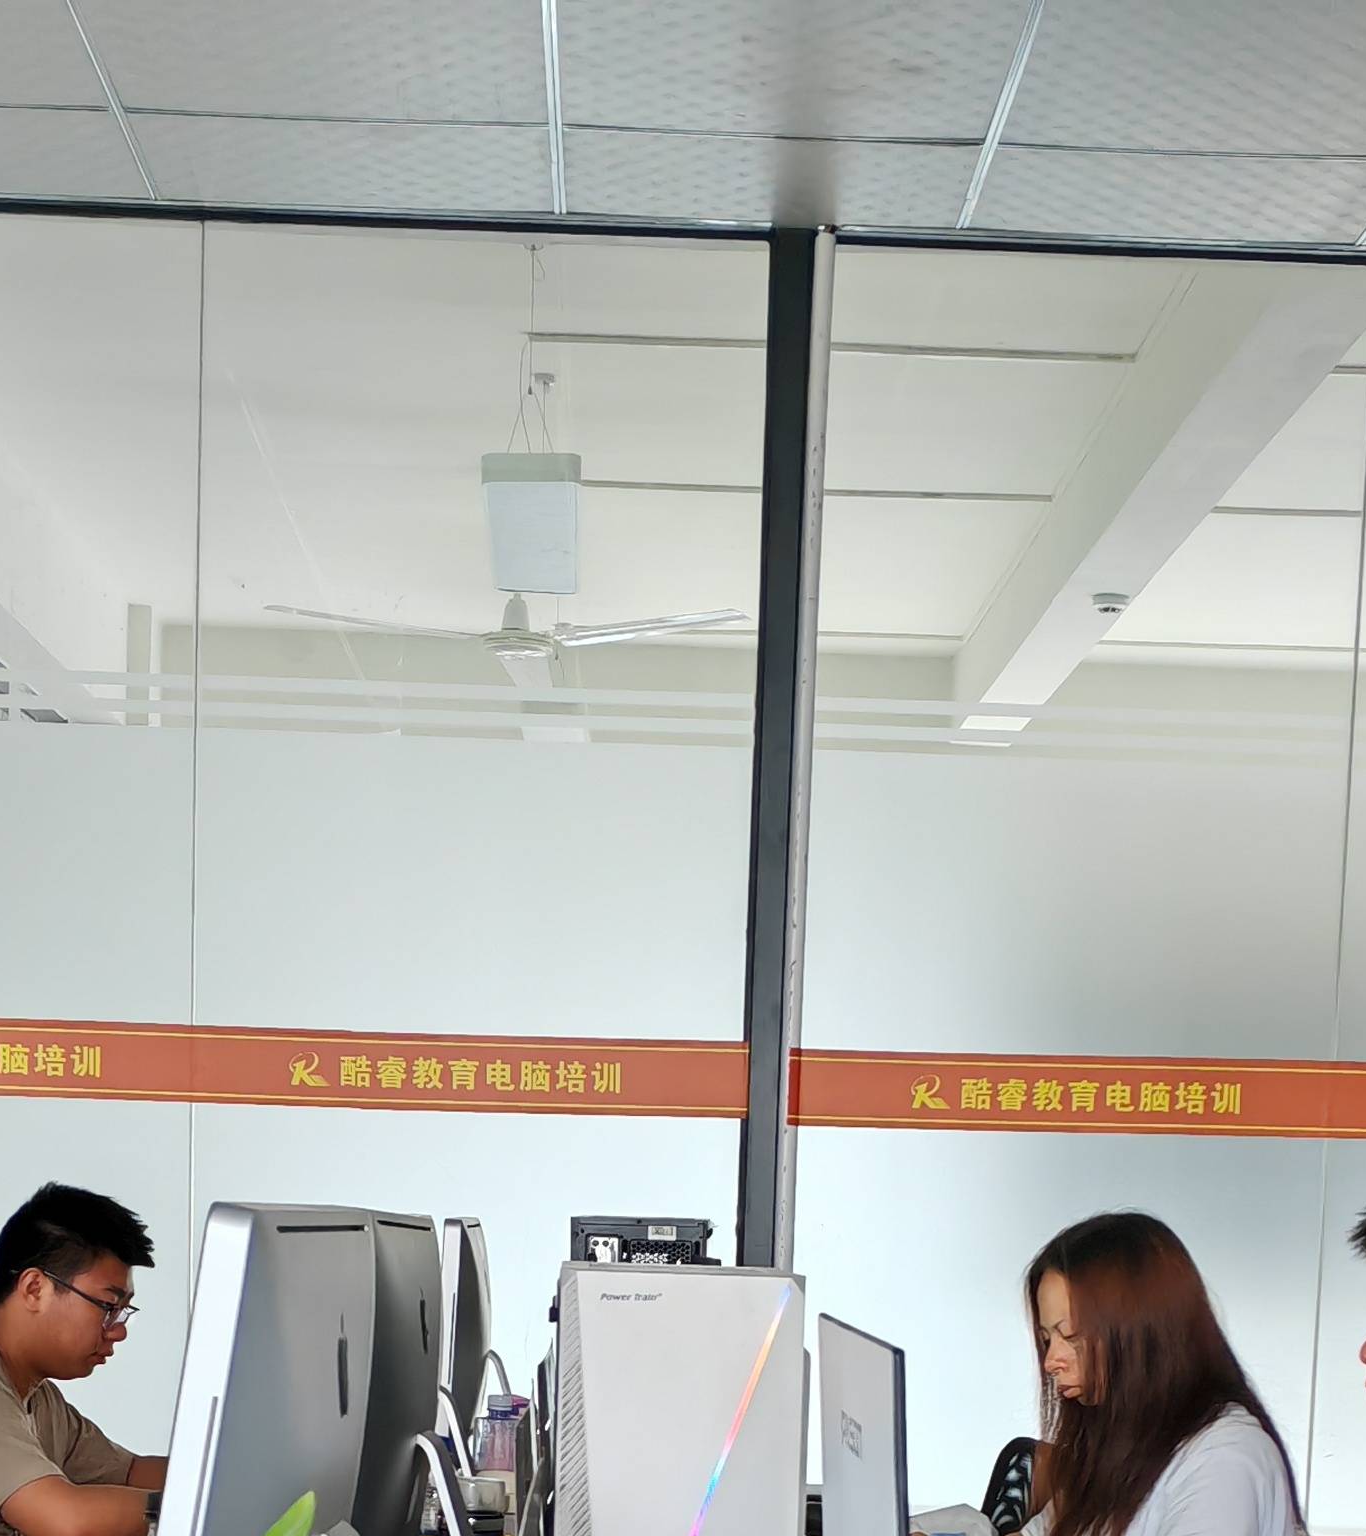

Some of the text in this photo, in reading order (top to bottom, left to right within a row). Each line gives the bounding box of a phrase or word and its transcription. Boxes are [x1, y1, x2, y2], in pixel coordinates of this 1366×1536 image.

[340, 1056, 622, 1093] 酷睿教育电脑培训
[959, 1078, 1242, 1115] 酷睿教育电脑培训
